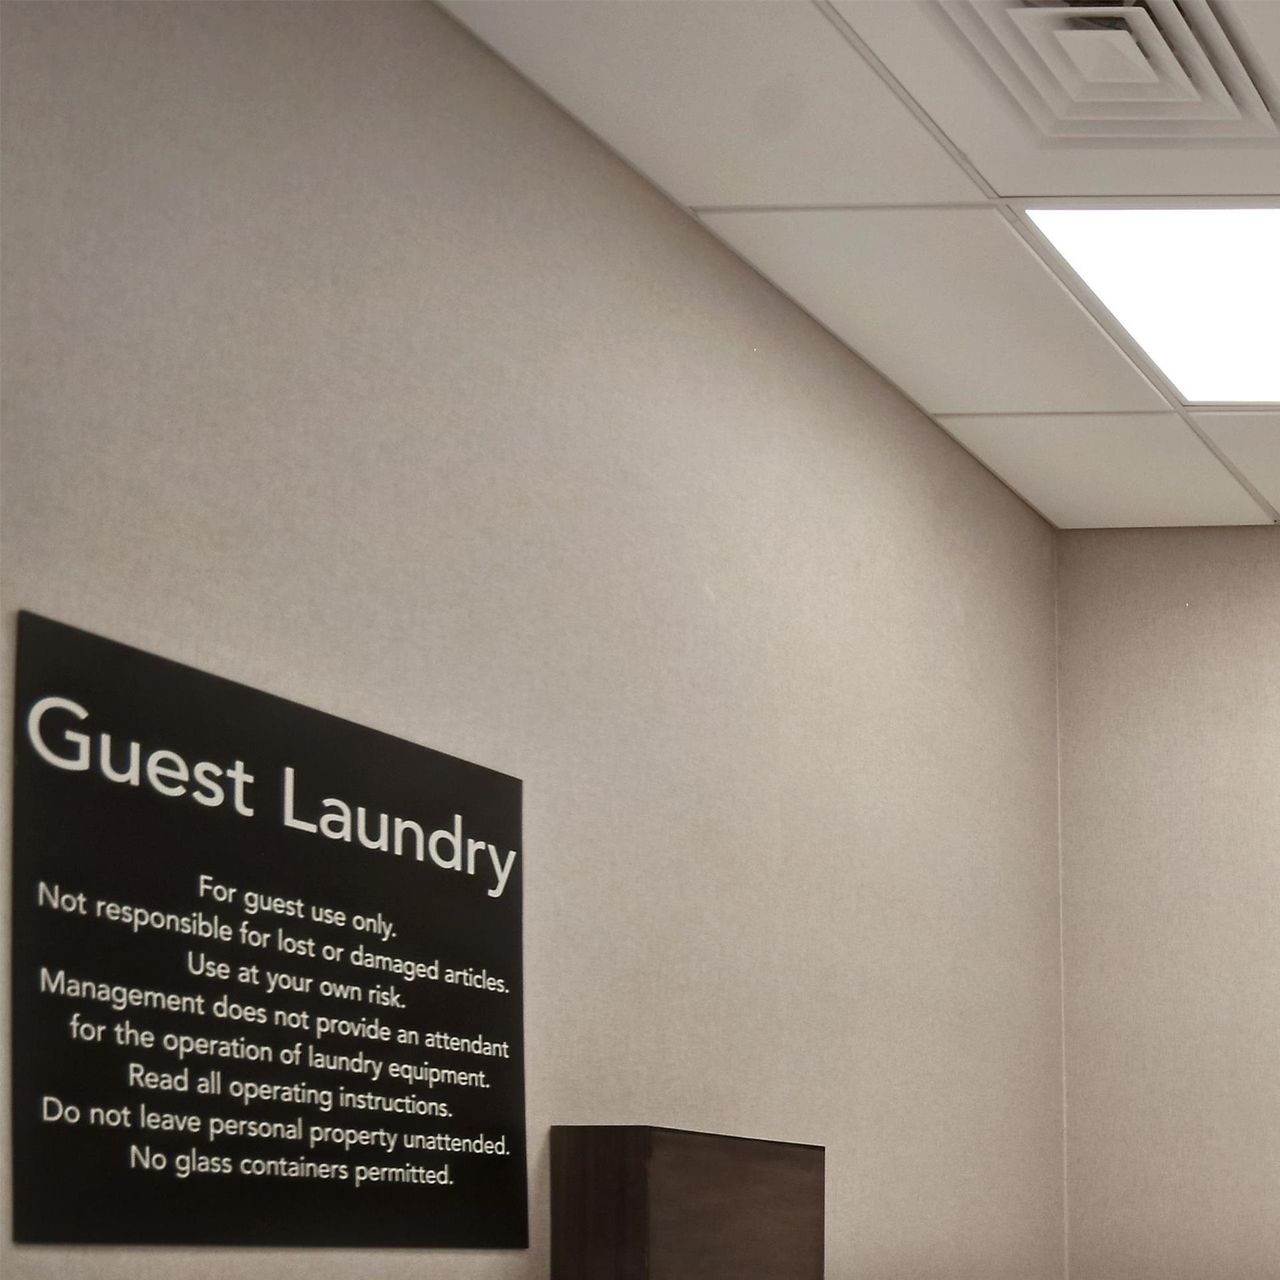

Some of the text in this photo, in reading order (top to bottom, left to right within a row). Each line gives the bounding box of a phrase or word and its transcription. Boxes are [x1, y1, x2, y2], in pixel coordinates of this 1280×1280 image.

[27, 696, 517, 898] Guest Laundry
[38, 881, 510, 994] Not responsible for lost or damaged articles.
[199, 874, 397, 942] For guest use only.
[40, 967, 510, 1059] Management does not provide an attendant
[188, 951, 406, 1009] Use at your own risk.
[69, 1012, 490, 1089] for the operation of laundry equipment.
[129, 1062, 453, 1118] Read all operating instructions.
[42, 1096, 510, 1156] Do not leave personal property unattended.
[130, 1144, 454, 1188] No glass containers permitted.
